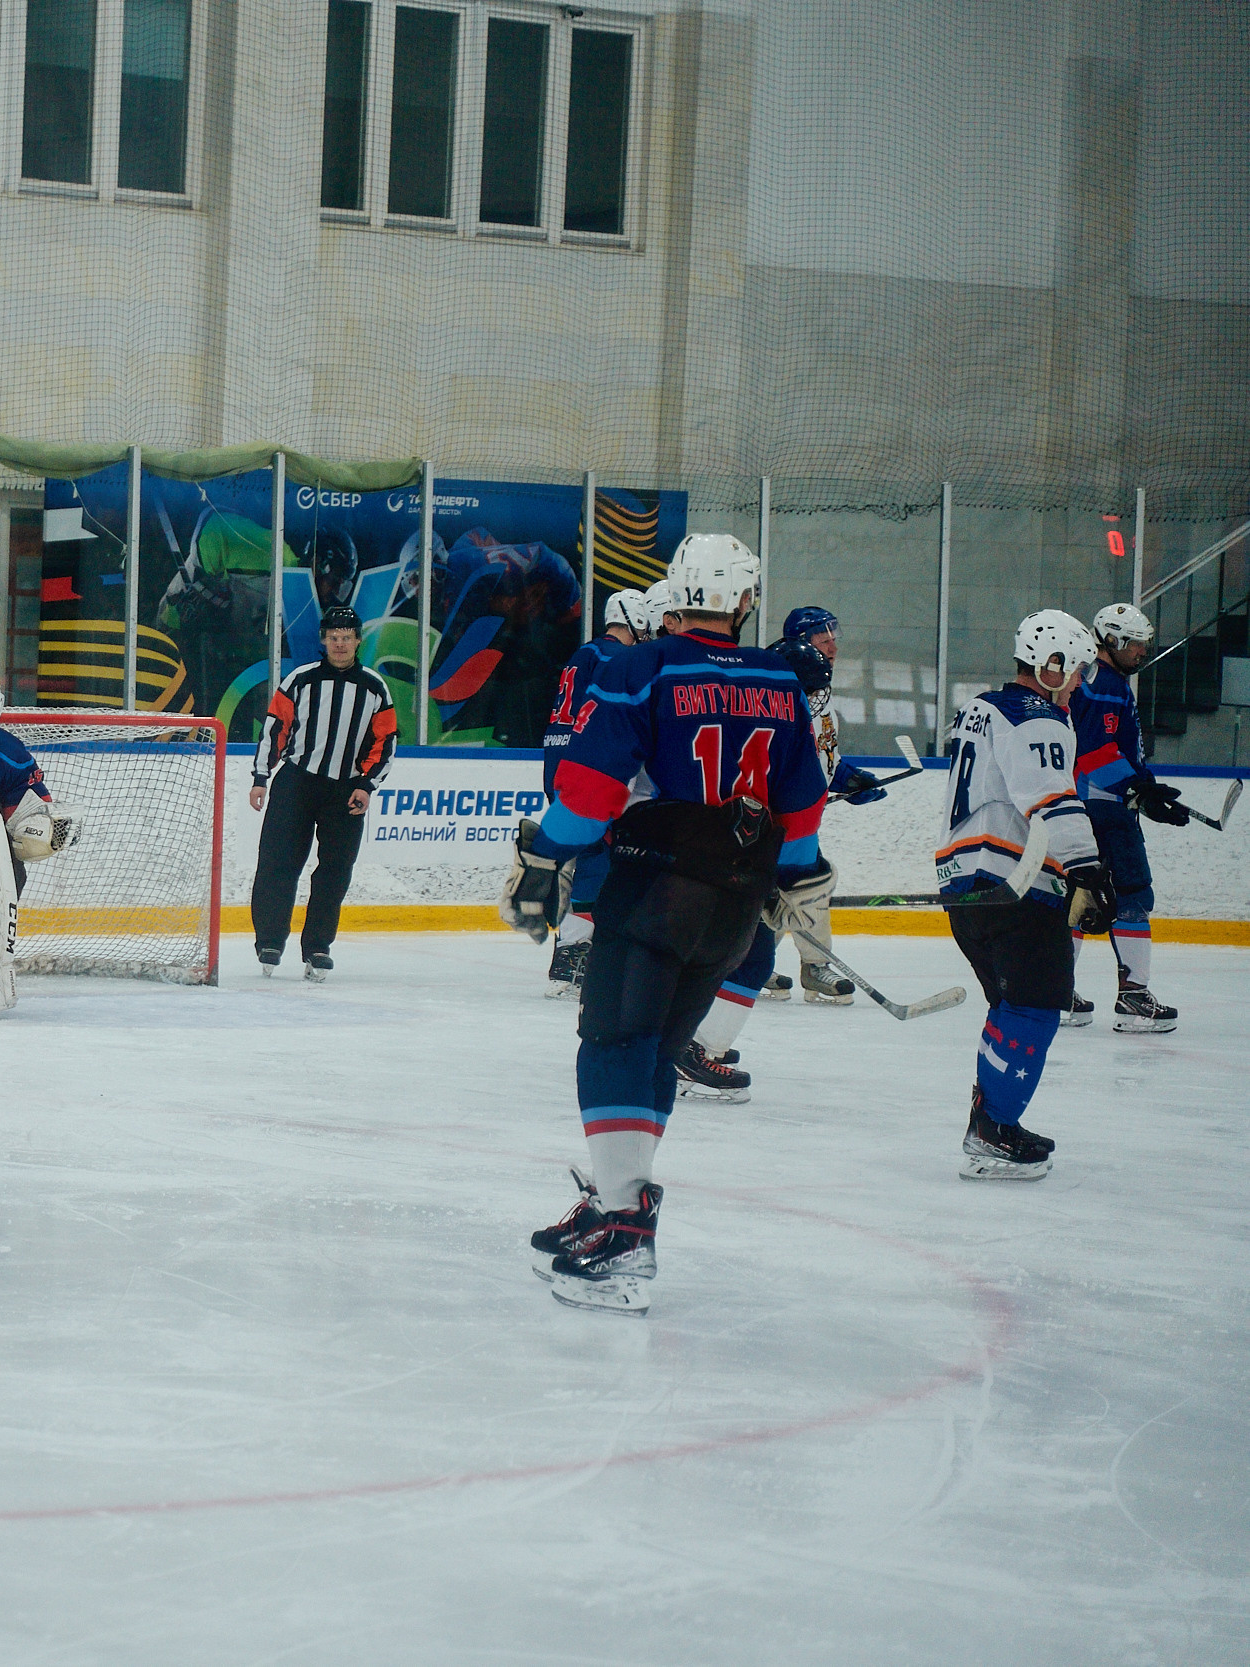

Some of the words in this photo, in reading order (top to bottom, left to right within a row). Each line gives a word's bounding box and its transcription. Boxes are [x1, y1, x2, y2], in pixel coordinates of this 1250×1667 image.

[319, 492, 362, 508] СБЕР
[685, 587, 705, 607] 14
[673, 684, 795, 723] ВИТУШКИН
[692, 724, 776, 807] 14
[1028, 742, 1065, 770] 78
[374, 821, 456, 842] ДАЛЬНИЙ
[6, 902, 18, 955] CCM
[585, 1246, 648, 1273] VAPOR
